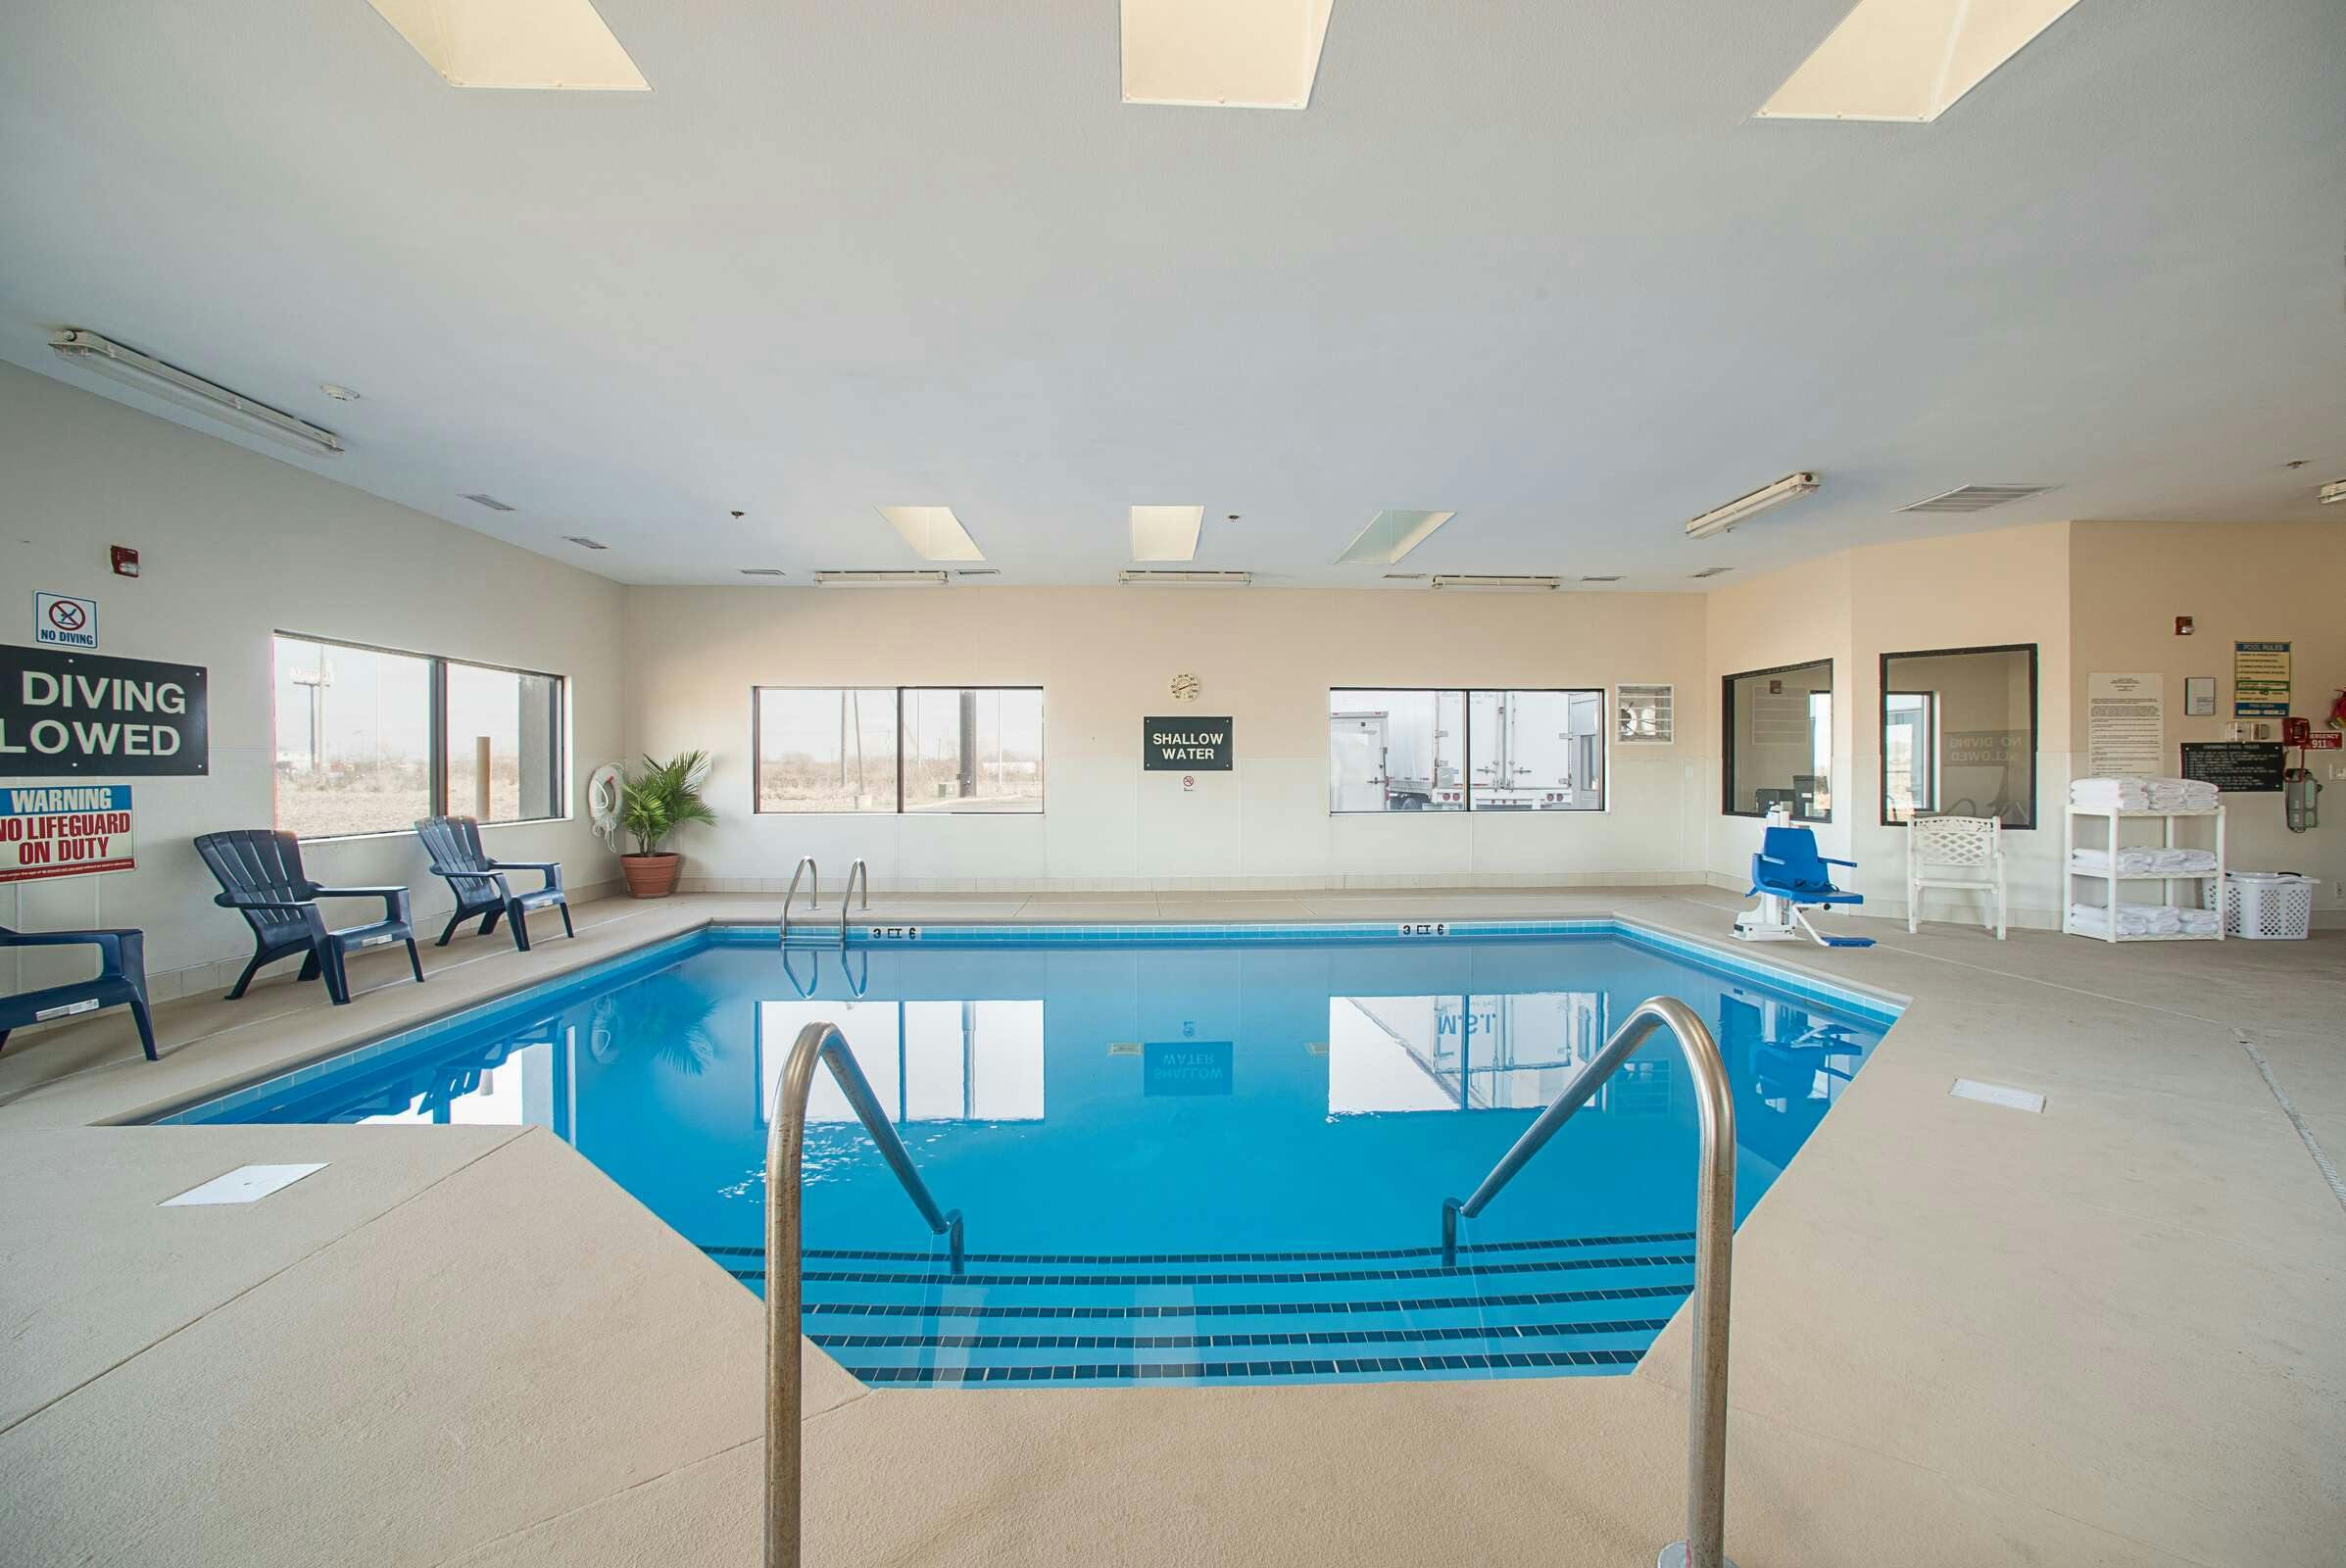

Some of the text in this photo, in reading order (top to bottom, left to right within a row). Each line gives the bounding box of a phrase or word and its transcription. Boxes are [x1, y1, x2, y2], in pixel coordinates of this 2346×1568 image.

[40, 629, 93, 645] NO DIVING
[22, 670, 186, 714] DIVING
[1152, 732, 1223, 745] SHALLOW
[2312, 739, 2326, 749] 911
[1162, 748, 1214, 760] WATER
[11, 787, 112, 813] WARNING
[26, 812, 130, 840] LIFEGUARD
[19, 836, 110, 865] ON DUTY
